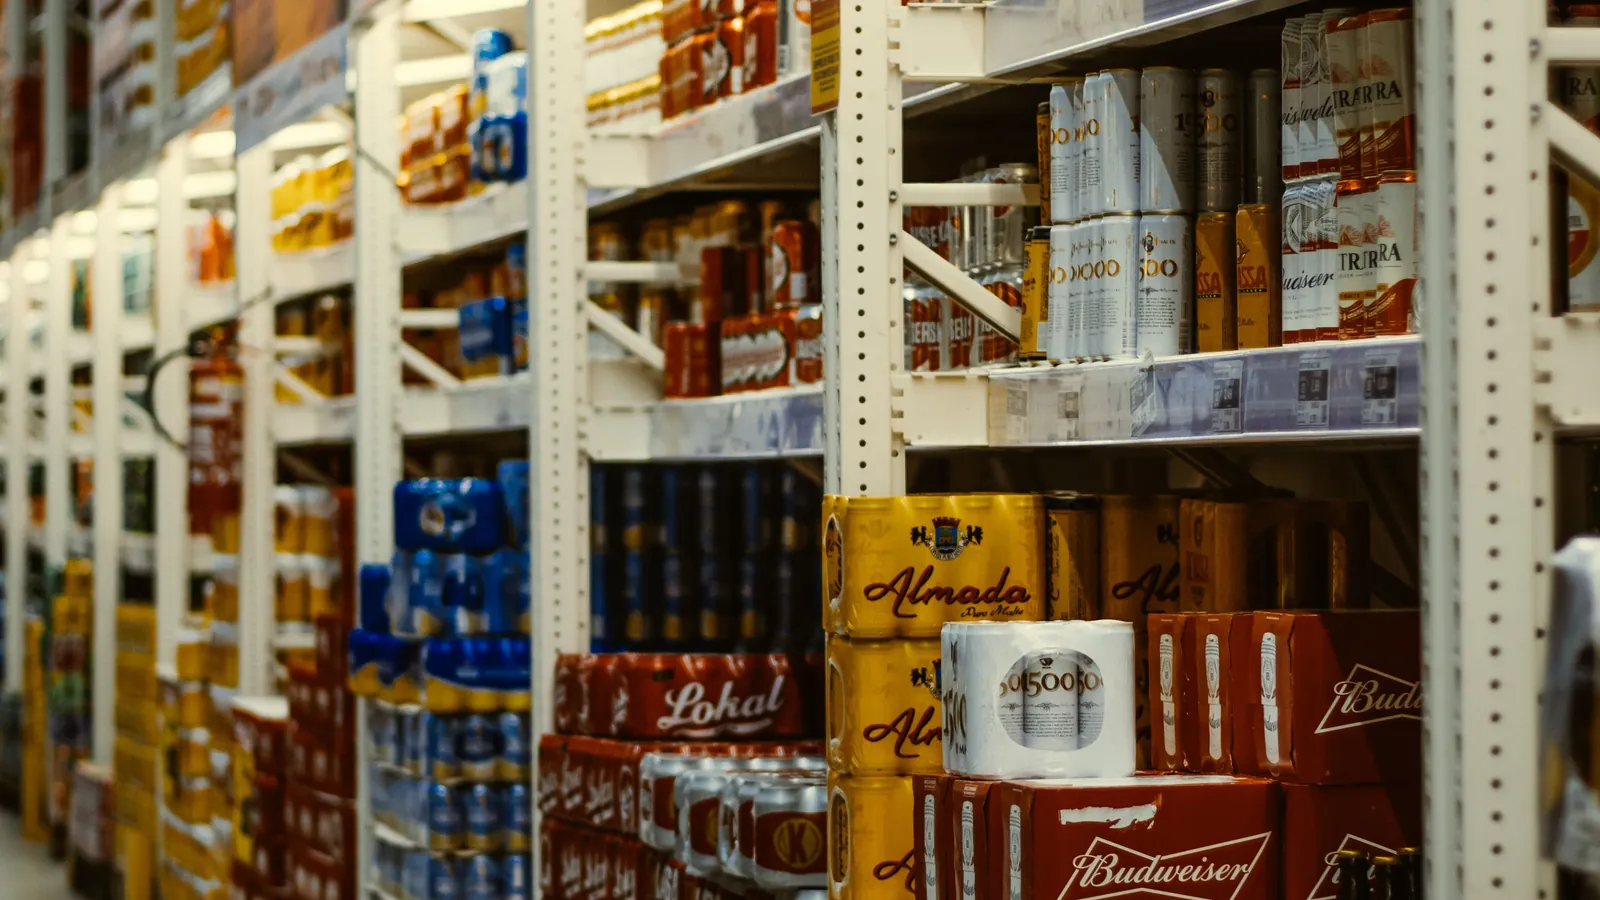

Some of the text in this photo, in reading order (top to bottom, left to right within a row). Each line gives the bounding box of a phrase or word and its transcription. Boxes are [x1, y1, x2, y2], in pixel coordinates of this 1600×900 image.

[863, 565, 1031, 618] Almada
[657, 675, 785, 731] Lokal
[1073, 852, 1251, 888] Budweiser
